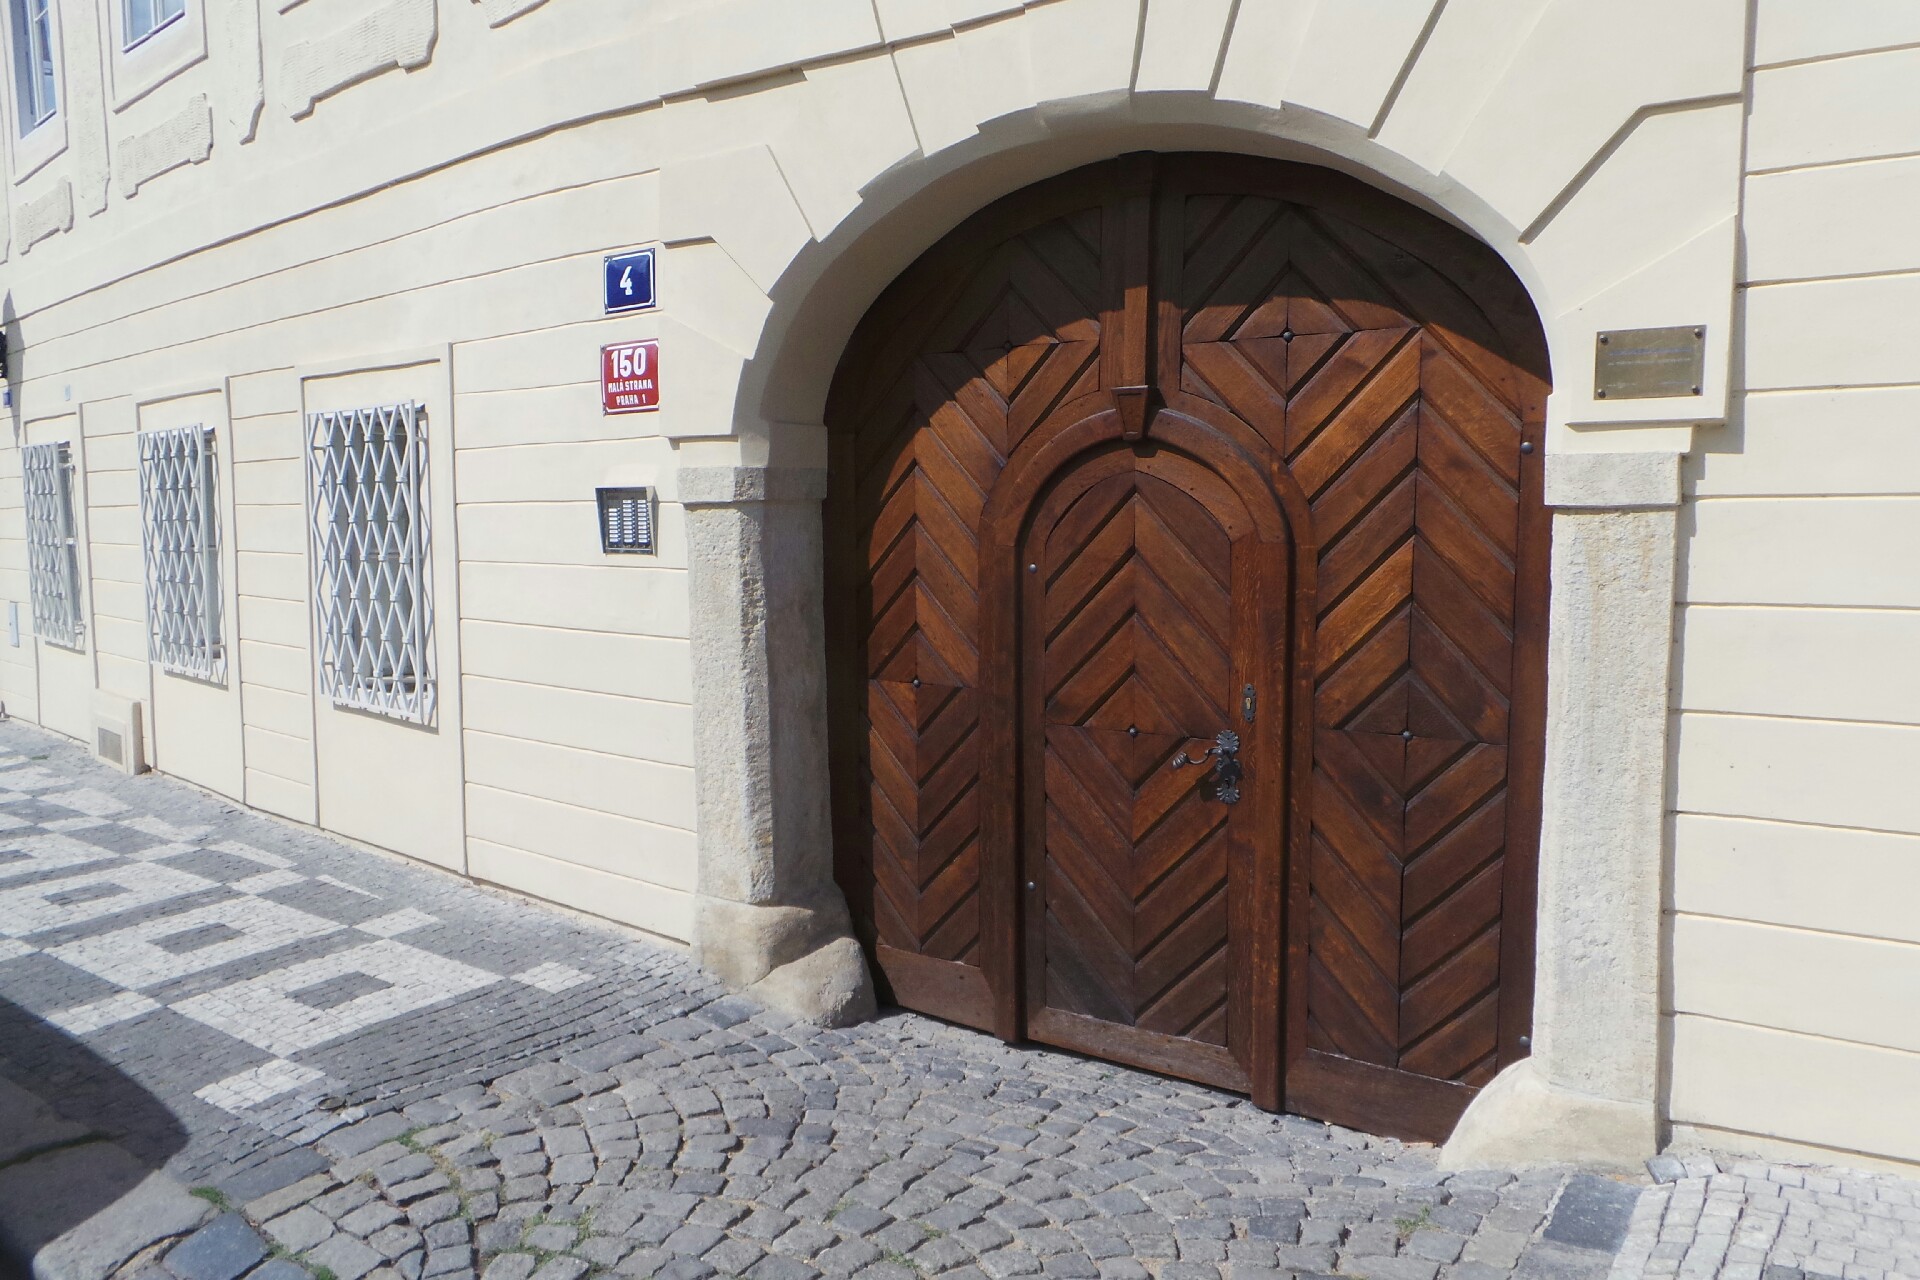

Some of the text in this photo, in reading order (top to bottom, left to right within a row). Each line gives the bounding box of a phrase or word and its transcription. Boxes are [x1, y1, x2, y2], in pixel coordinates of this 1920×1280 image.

[620, 266, 633, 296] 4
[611, 347, 646, 379] 150
[625, 379, 653, 391] STRANA
[616, 394, 646, 406] PRAHA 1
